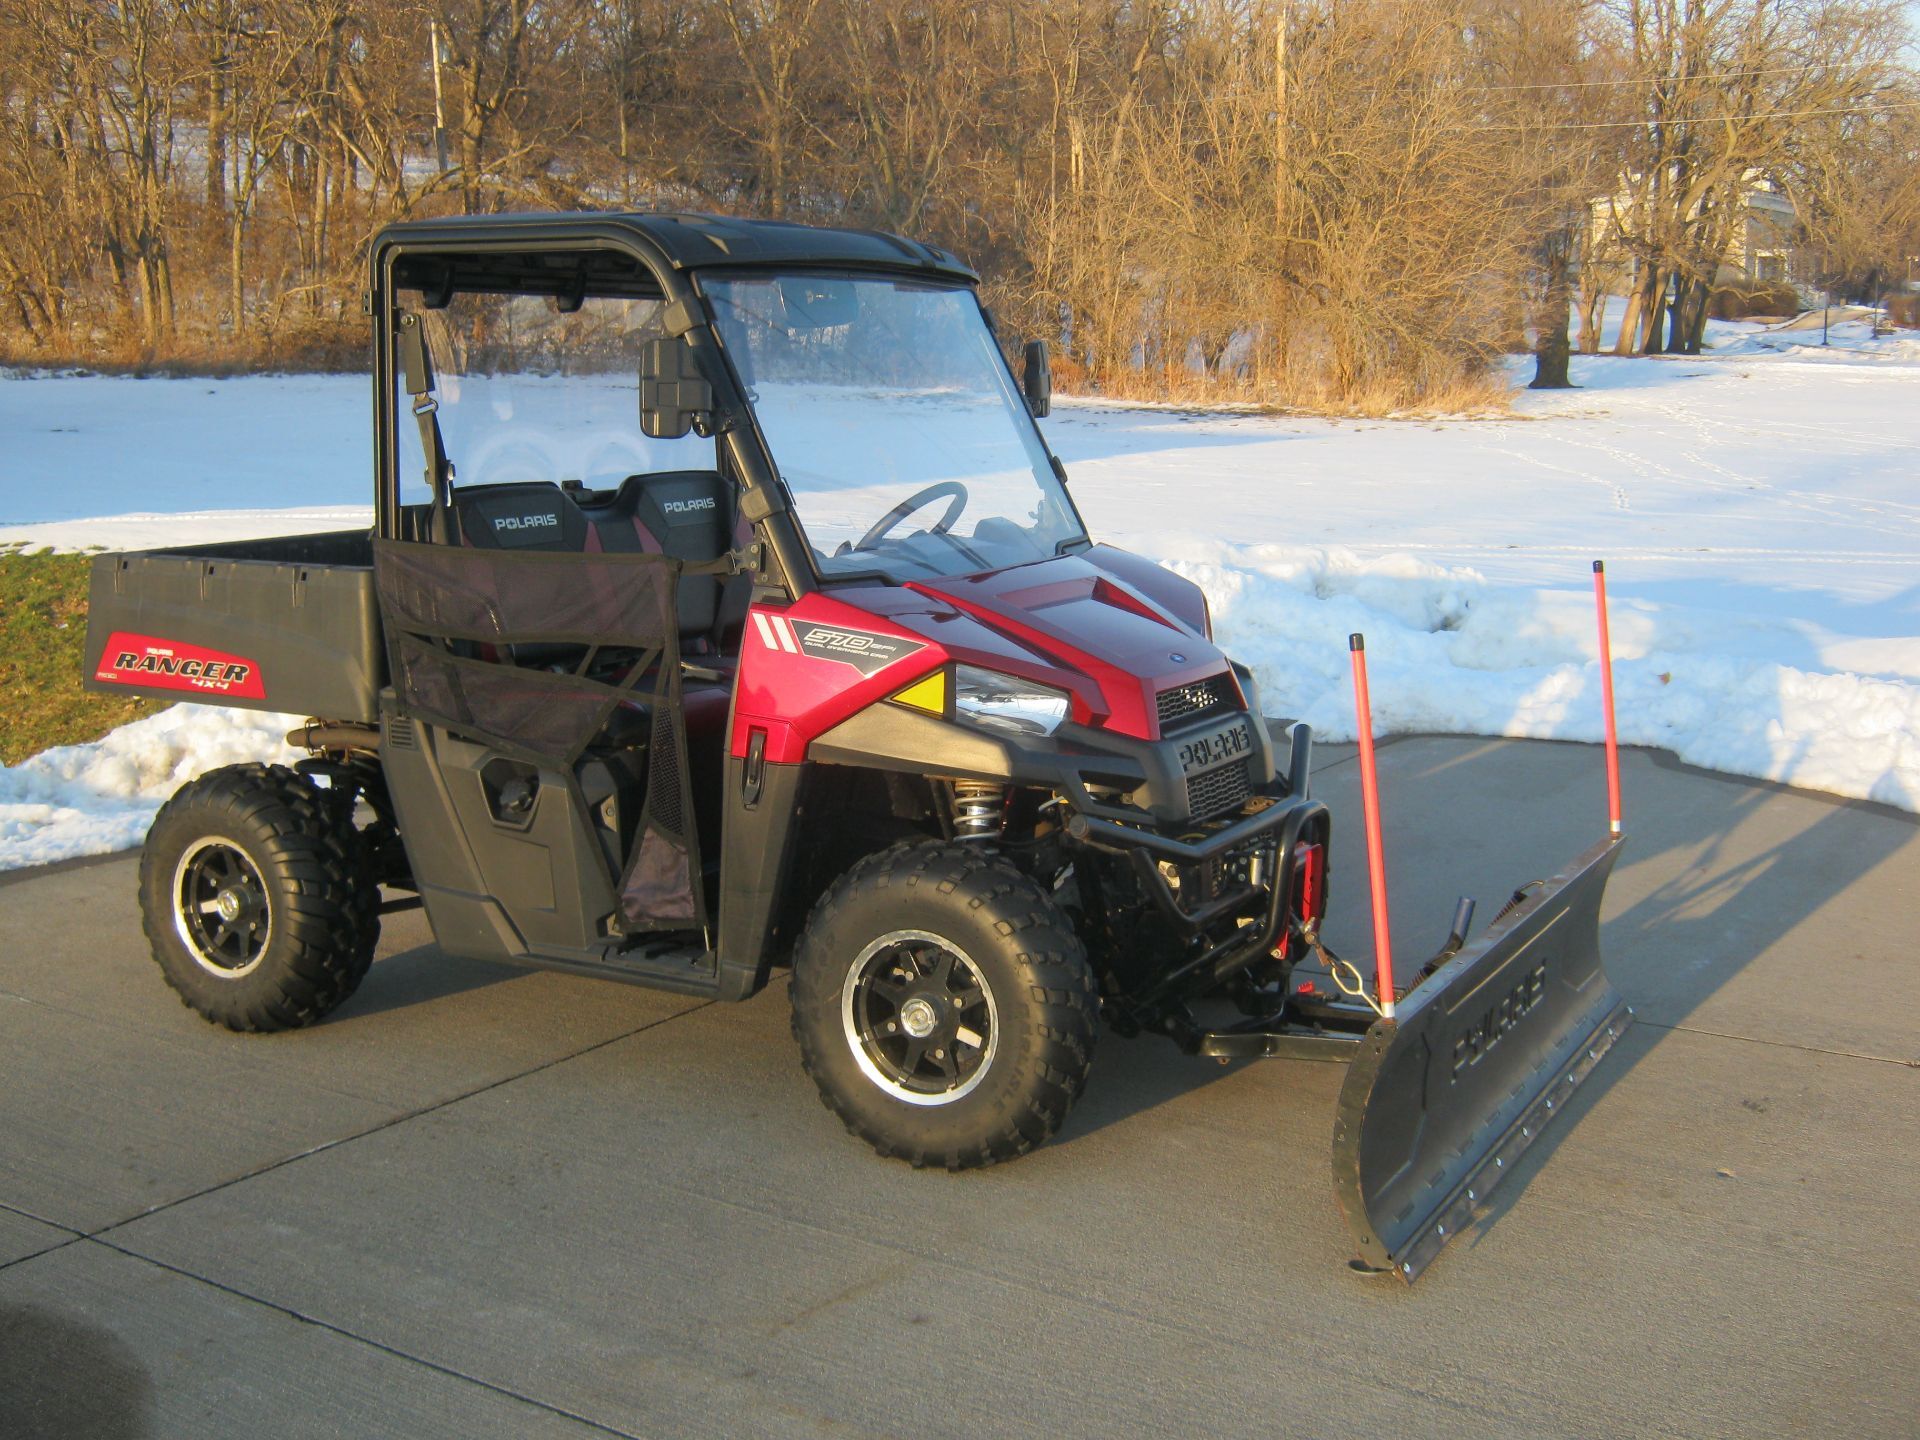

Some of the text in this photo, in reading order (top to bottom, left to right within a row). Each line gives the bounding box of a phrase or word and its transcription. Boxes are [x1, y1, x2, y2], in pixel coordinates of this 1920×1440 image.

[663, 497, 716, 513] POLARIS
[494, 513, 558, 531] POLARIS
[804, 628, 874, 650] 570
[113, 652, 250, 684] RANGER
[1179, 724, 1250, 773] POLARIS
[1451, 957, 1547, 1086] POLARIS
